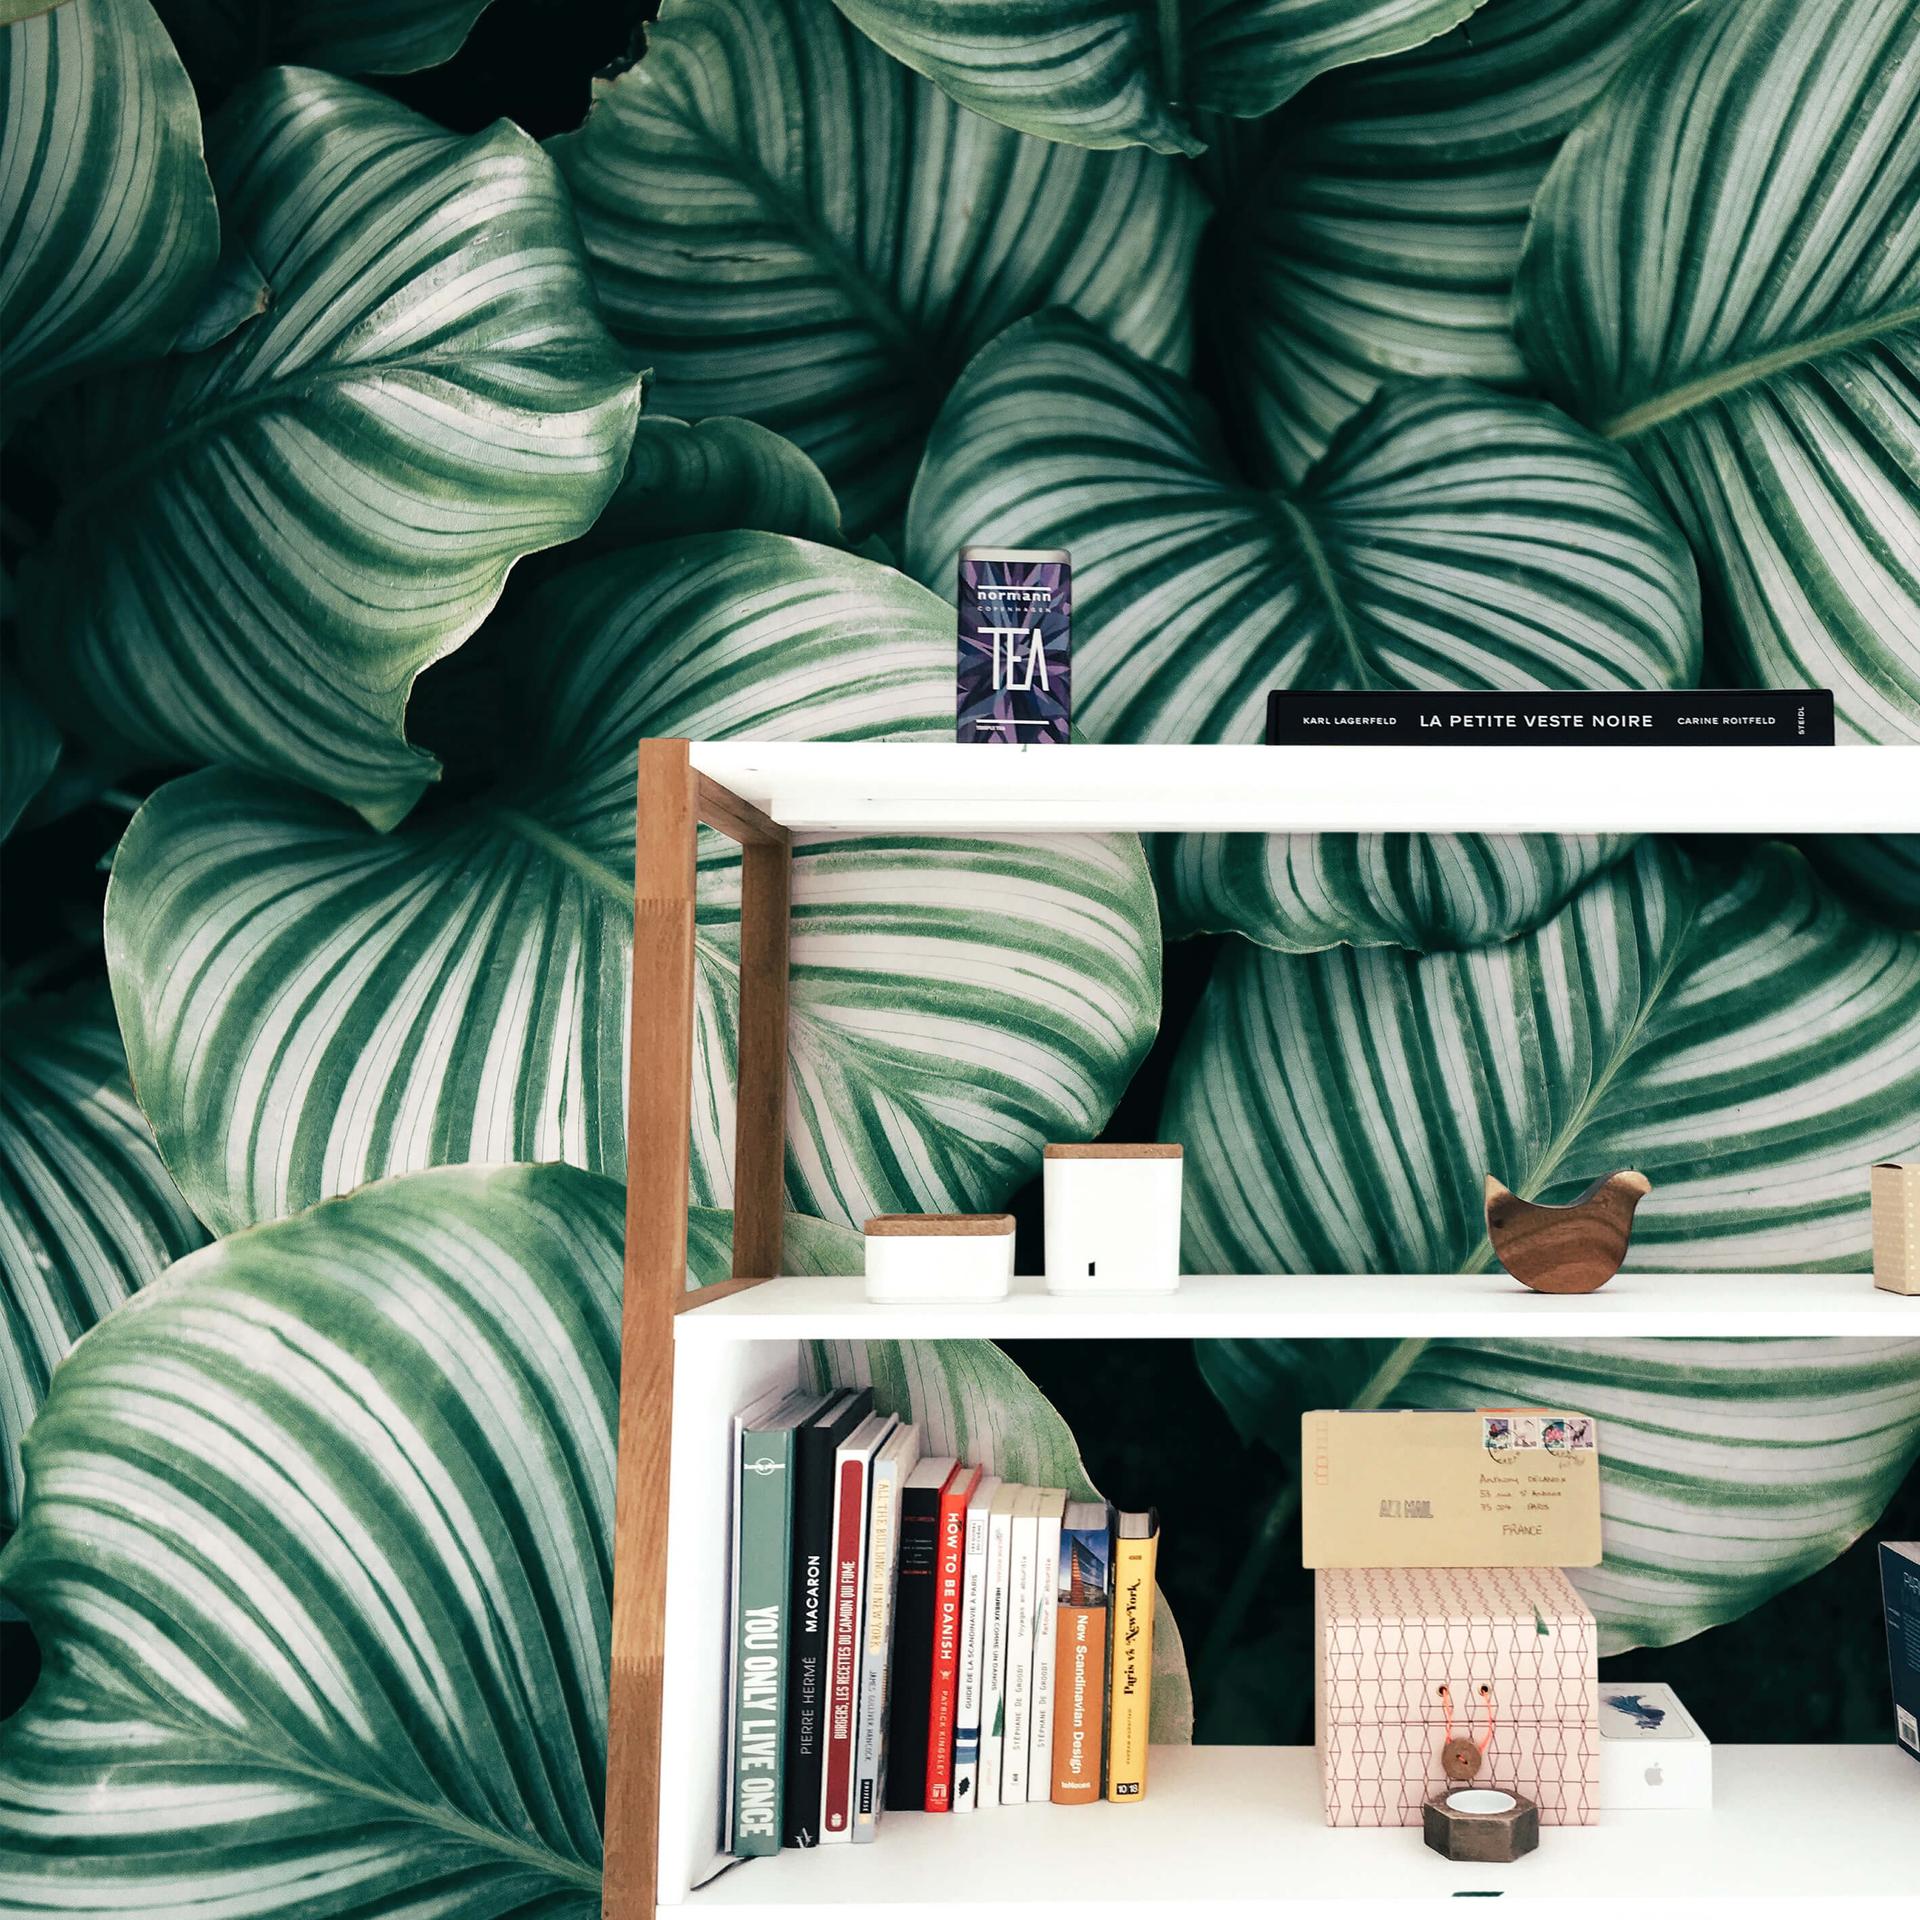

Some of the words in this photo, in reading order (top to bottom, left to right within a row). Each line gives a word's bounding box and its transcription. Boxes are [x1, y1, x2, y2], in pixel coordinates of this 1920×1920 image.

[978, 592, 1051, 601] normann
[978, 627, 1049, 691] TEA
[1303, 716, 1331, 725] KARL
[1334, 716, 1397, 725] LAGERFELD
[1420, 715, 1442, 728] LA
[1450, 715, 1517, 728] PETITE
[1524, 715, 1584, 728] VESTE
[1592, 715, 1654, 728] NOIRE
[1677, 717, 1719, 725] CARINE
[1722, 717, 1776, 725] ROITFELD
[877, 1484, 888, 1501] ALL
[876, 1505, 887, 1524] THE
[1502, 1524, 1543, 1535] FRANCE
[947, 1512, 959, 1548] HOW
[873, 1528, 887, 1579] BUILDINGS
[946, 1554, 956, 1572] TO
[841, 1561, 855, 1583] FUME
[970, 1574, 978, 1596] PARIS
[806, 1556, 820, 1632] MACARON
[841, 1585, 855, 1598] QUI
[873, 1583, 884, 1592] IN
[944, 1580, 955, 1596] BE
[1125, 1579, 1141, 1616] York
[839, 1600, 853, 1632] CAMION
[872, 1597, 883, 1620] NEW
[744, 1606, 779, 1649] YOU
[838, 1634, 852, 1644] DU
[870, 1624, 881, 1648] YORK
[941, 1603, 954, 1660] DANISH
[968, 1605, 976, 1658] SCANDINAVIE
[992, 1622, 1000, 1650] COMME
[1076, 1615, 1088, 1641] New
[1125, 1615, 1139, 1646] New
[836, 1647, 851, 1684] RECETTES
[967, 1660, 974, 1670] LA
[992, 1651, 998, 1661] UN
[742, 1657, 777, 1712] ONLY
[801, 1657, 816, 1703] HERMÉ
[868, 1670, 877, 1692] JAMES
[967, 1673, 973, 1683] DE
[1073, 1645, 1087, 1726] Scandinavian
[1123, 1665, 1138, 1695] Paris
[836, 1687, 849, 1700] LES
[834, 1703, 849, 1739] BURGERS,
[939, 1690, 949, 1728] PATRICK
[741, 1720, 776, 1770] LIVE
[800, 1710, 814, 1754] PIERRE
[864, 1729, 875, 1762] HANCOCK
[936, 1731, 946, 1776] KINGSLEY
[1070, 1732, 1084, 1774] Design
[740, 1778, 774, 1838] ONCE
[861, 1781, 871, 1812] UNIVERSE
